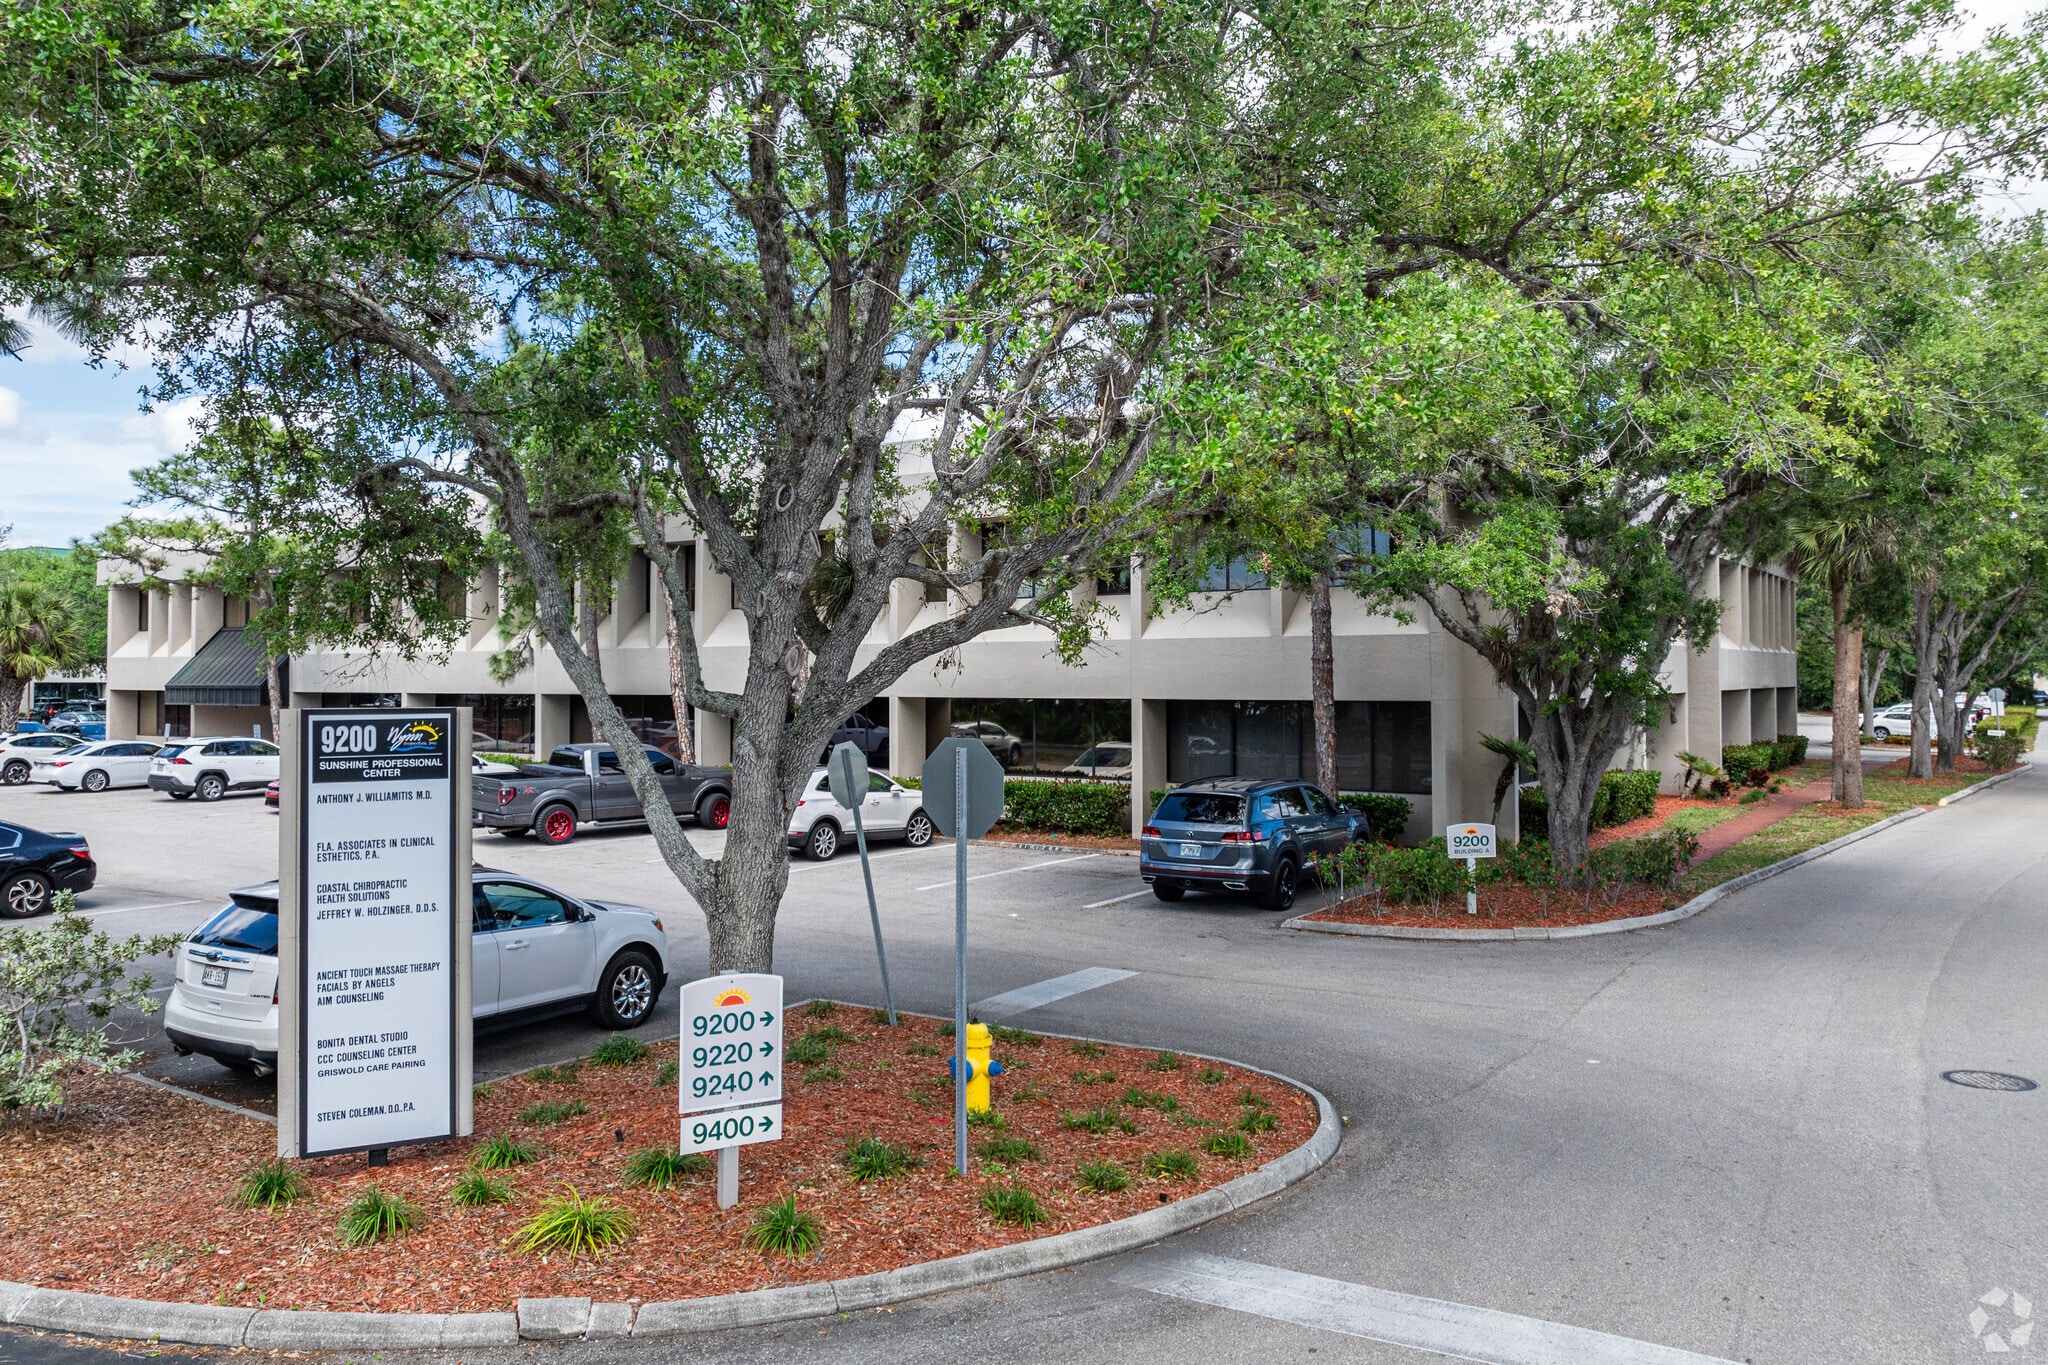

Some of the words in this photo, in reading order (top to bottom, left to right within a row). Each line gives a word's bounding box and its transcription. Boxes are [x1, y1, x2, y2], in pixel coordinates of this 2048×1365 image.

[321, 725, 377, 753] 9200
[387, 723, 423, 751] Wynn
[319, 760, 368, 770] SUNSHINE
[372, 758, 442, 768] PROFESSIONAL
[363, 768, 400, 778] CENTER
[316, 793, 354, 804] ANTHONY
[356, 793, 363, 802] J.
[365, 791, 413, 802] WILLIAMITIS
[416, 790, 432, 800] M.D.
[316, 842, 334, 852] FLA.
[337, 839, 386, 851] ASSOCIATES
[389, 838, 397, 848] IN
[400, 836, 435, 848] CLINICAL
[1453, 836, 1489, 847] 9200
[365, 850, 380, 860] P.A.
[316, 883, 351, 894] COASTAL
[353, 879, 408, 892] CHIROPRACTIC
[316, 893, 346, 904] HEALTH
[348, 890, 390, 902] SOLUTIONS
[316, 909, 351, 920] JEFFREY
[354, 908, 364, 917] W.
[416, 903, 439, 913] D.D.S.
[316, 970, 348, 981] ANCIENT
[350, 967, 373, 978] TOUCH
[375, 965, 408, 976] MASSAGE
[410, 962, 440, 973] THERAPY
[317, 982, 348, 993] FACIALS
[352, 980, 362, 990] BY
[365, 978, 395, 989] ANGELS
[317, 996, 332, 1006] AIM
[336, 992, 384, 1004] COUNSELING
[692, 1011, 755, 1037] 9200
[317, 1038, 345, 1049] BONITA
[348, 1034, 378, 1046] DENTAL
[380, 1031, 408, 1043] STUDIO
[317, 1054, 334, 1064] CCC
[337, 1049, 385, 1062] COUNSELING
[388, 1045, 417, 1056] CENTER
[692, 1042, 752, 1068] 9220
[317, 1066, 364, 1078] GRISWOLD
[366, 1063, 389, 1072] CARE
[392, 1060, 426, 1070] PAIRING
[692, 1071, 753, 1098] 9240
[317, 1110, 346, 1122] STEVEN
[692, 1116, 754, 1145] 9400
